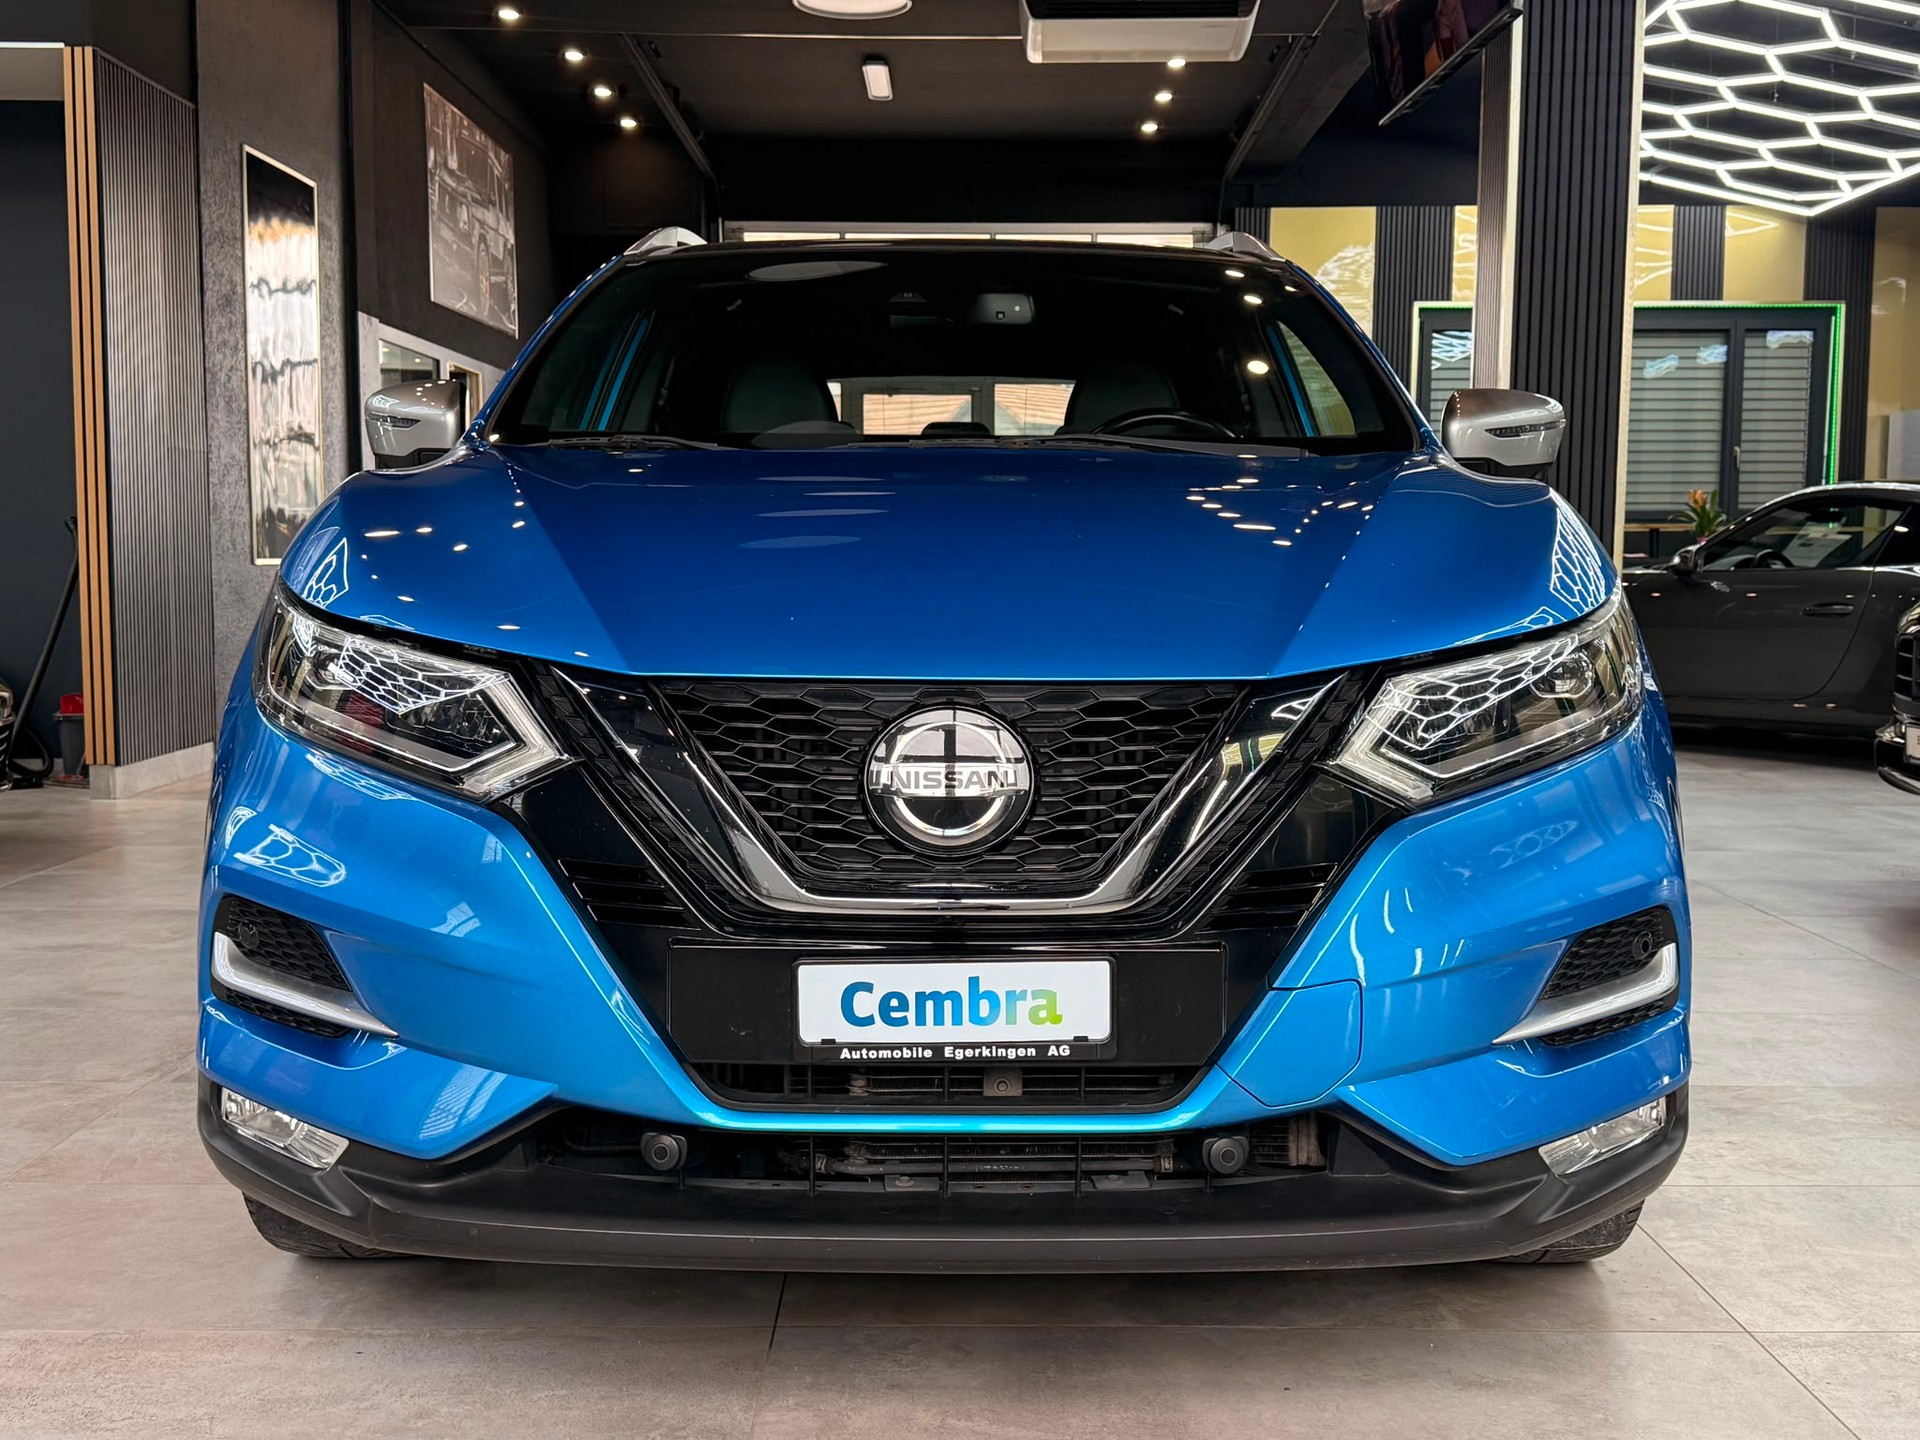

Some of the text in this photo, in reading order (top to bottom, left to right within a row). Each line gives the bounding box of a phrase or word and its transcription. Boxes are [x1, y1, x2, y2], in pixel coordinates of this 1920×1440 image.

[889, 770, 1011, 790] NISSAN
[840, 975, 1063, 1027] Cembra
[839, 1044, 1071, 1060] Automobile Egerkingen AG
